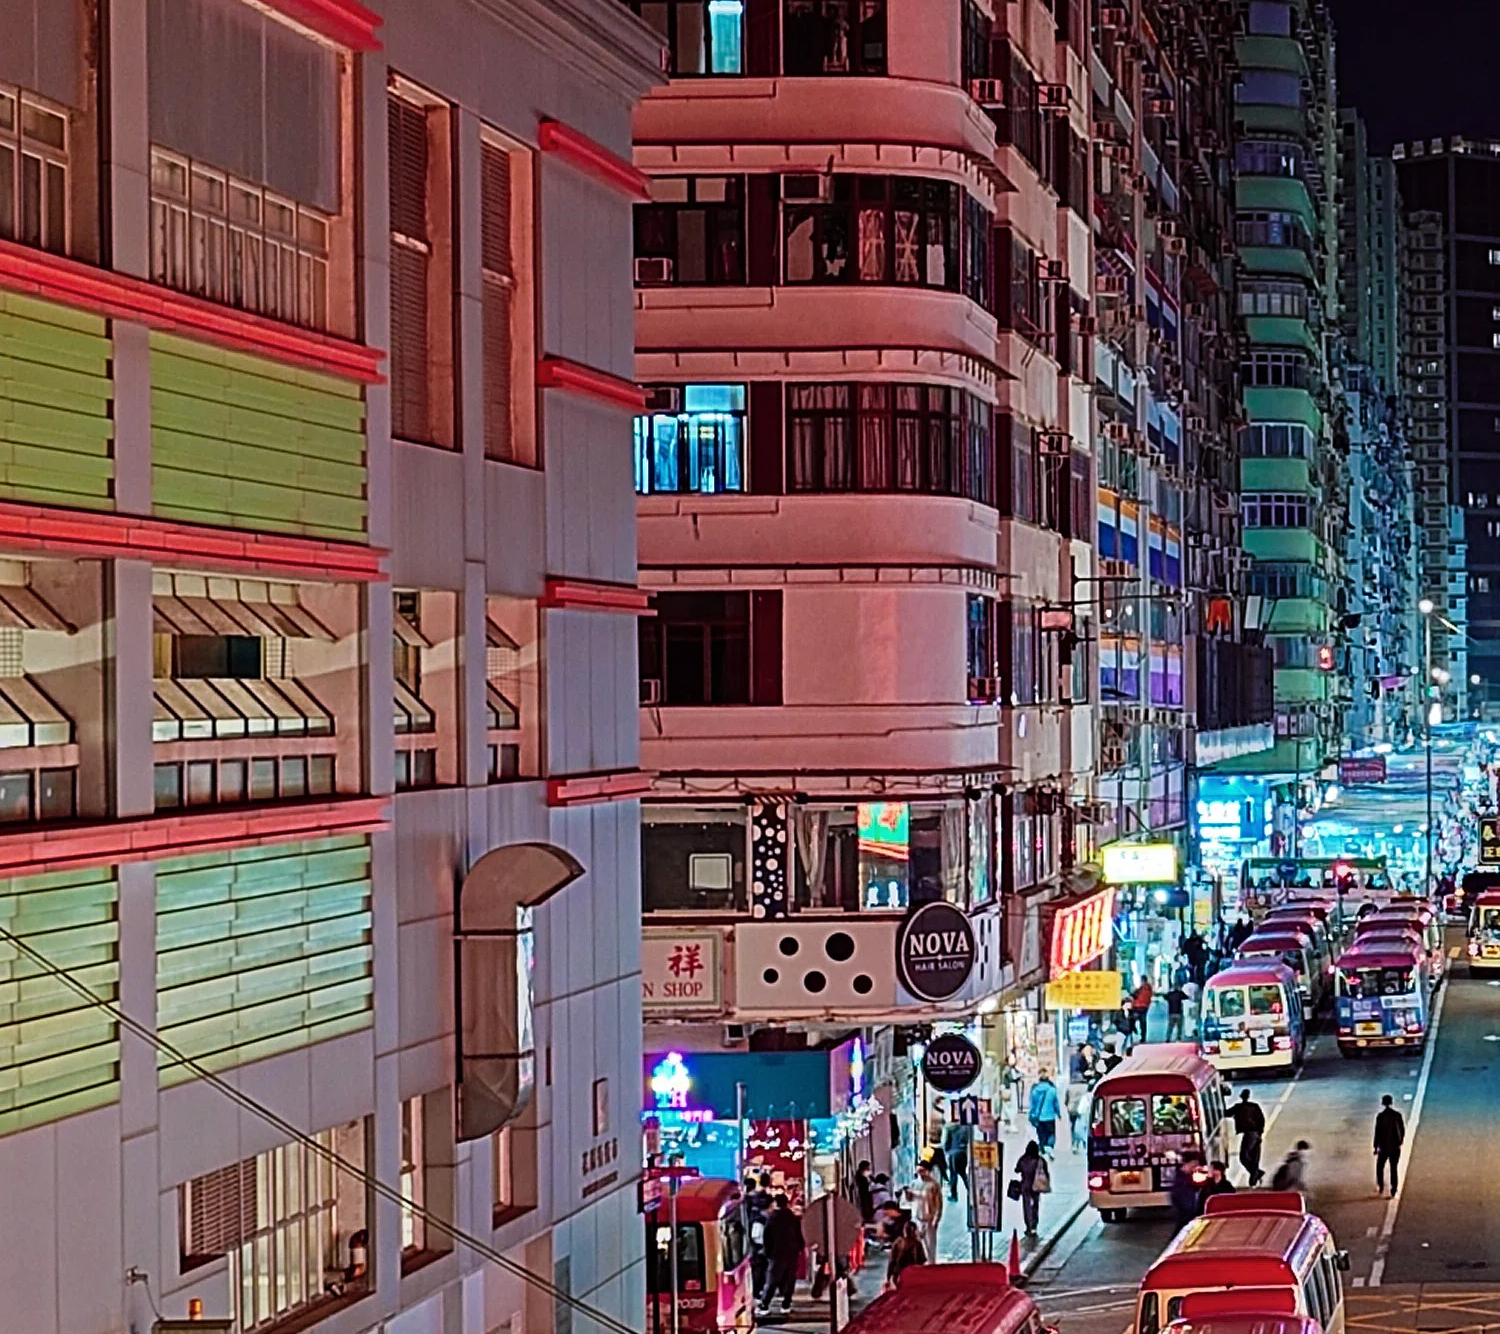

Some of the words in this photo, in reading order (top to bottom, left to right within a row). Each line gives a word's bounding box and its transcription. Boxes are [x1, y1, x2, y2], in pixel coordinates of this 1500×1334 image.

[909, 930, 970, 955] NOVA
[668, 944, 704, 978] 祥
[937, 961, 966, 970] SALON
[663, 982, 703, 997] SHOP
[926, 1051, 975, 1066] NOVA
